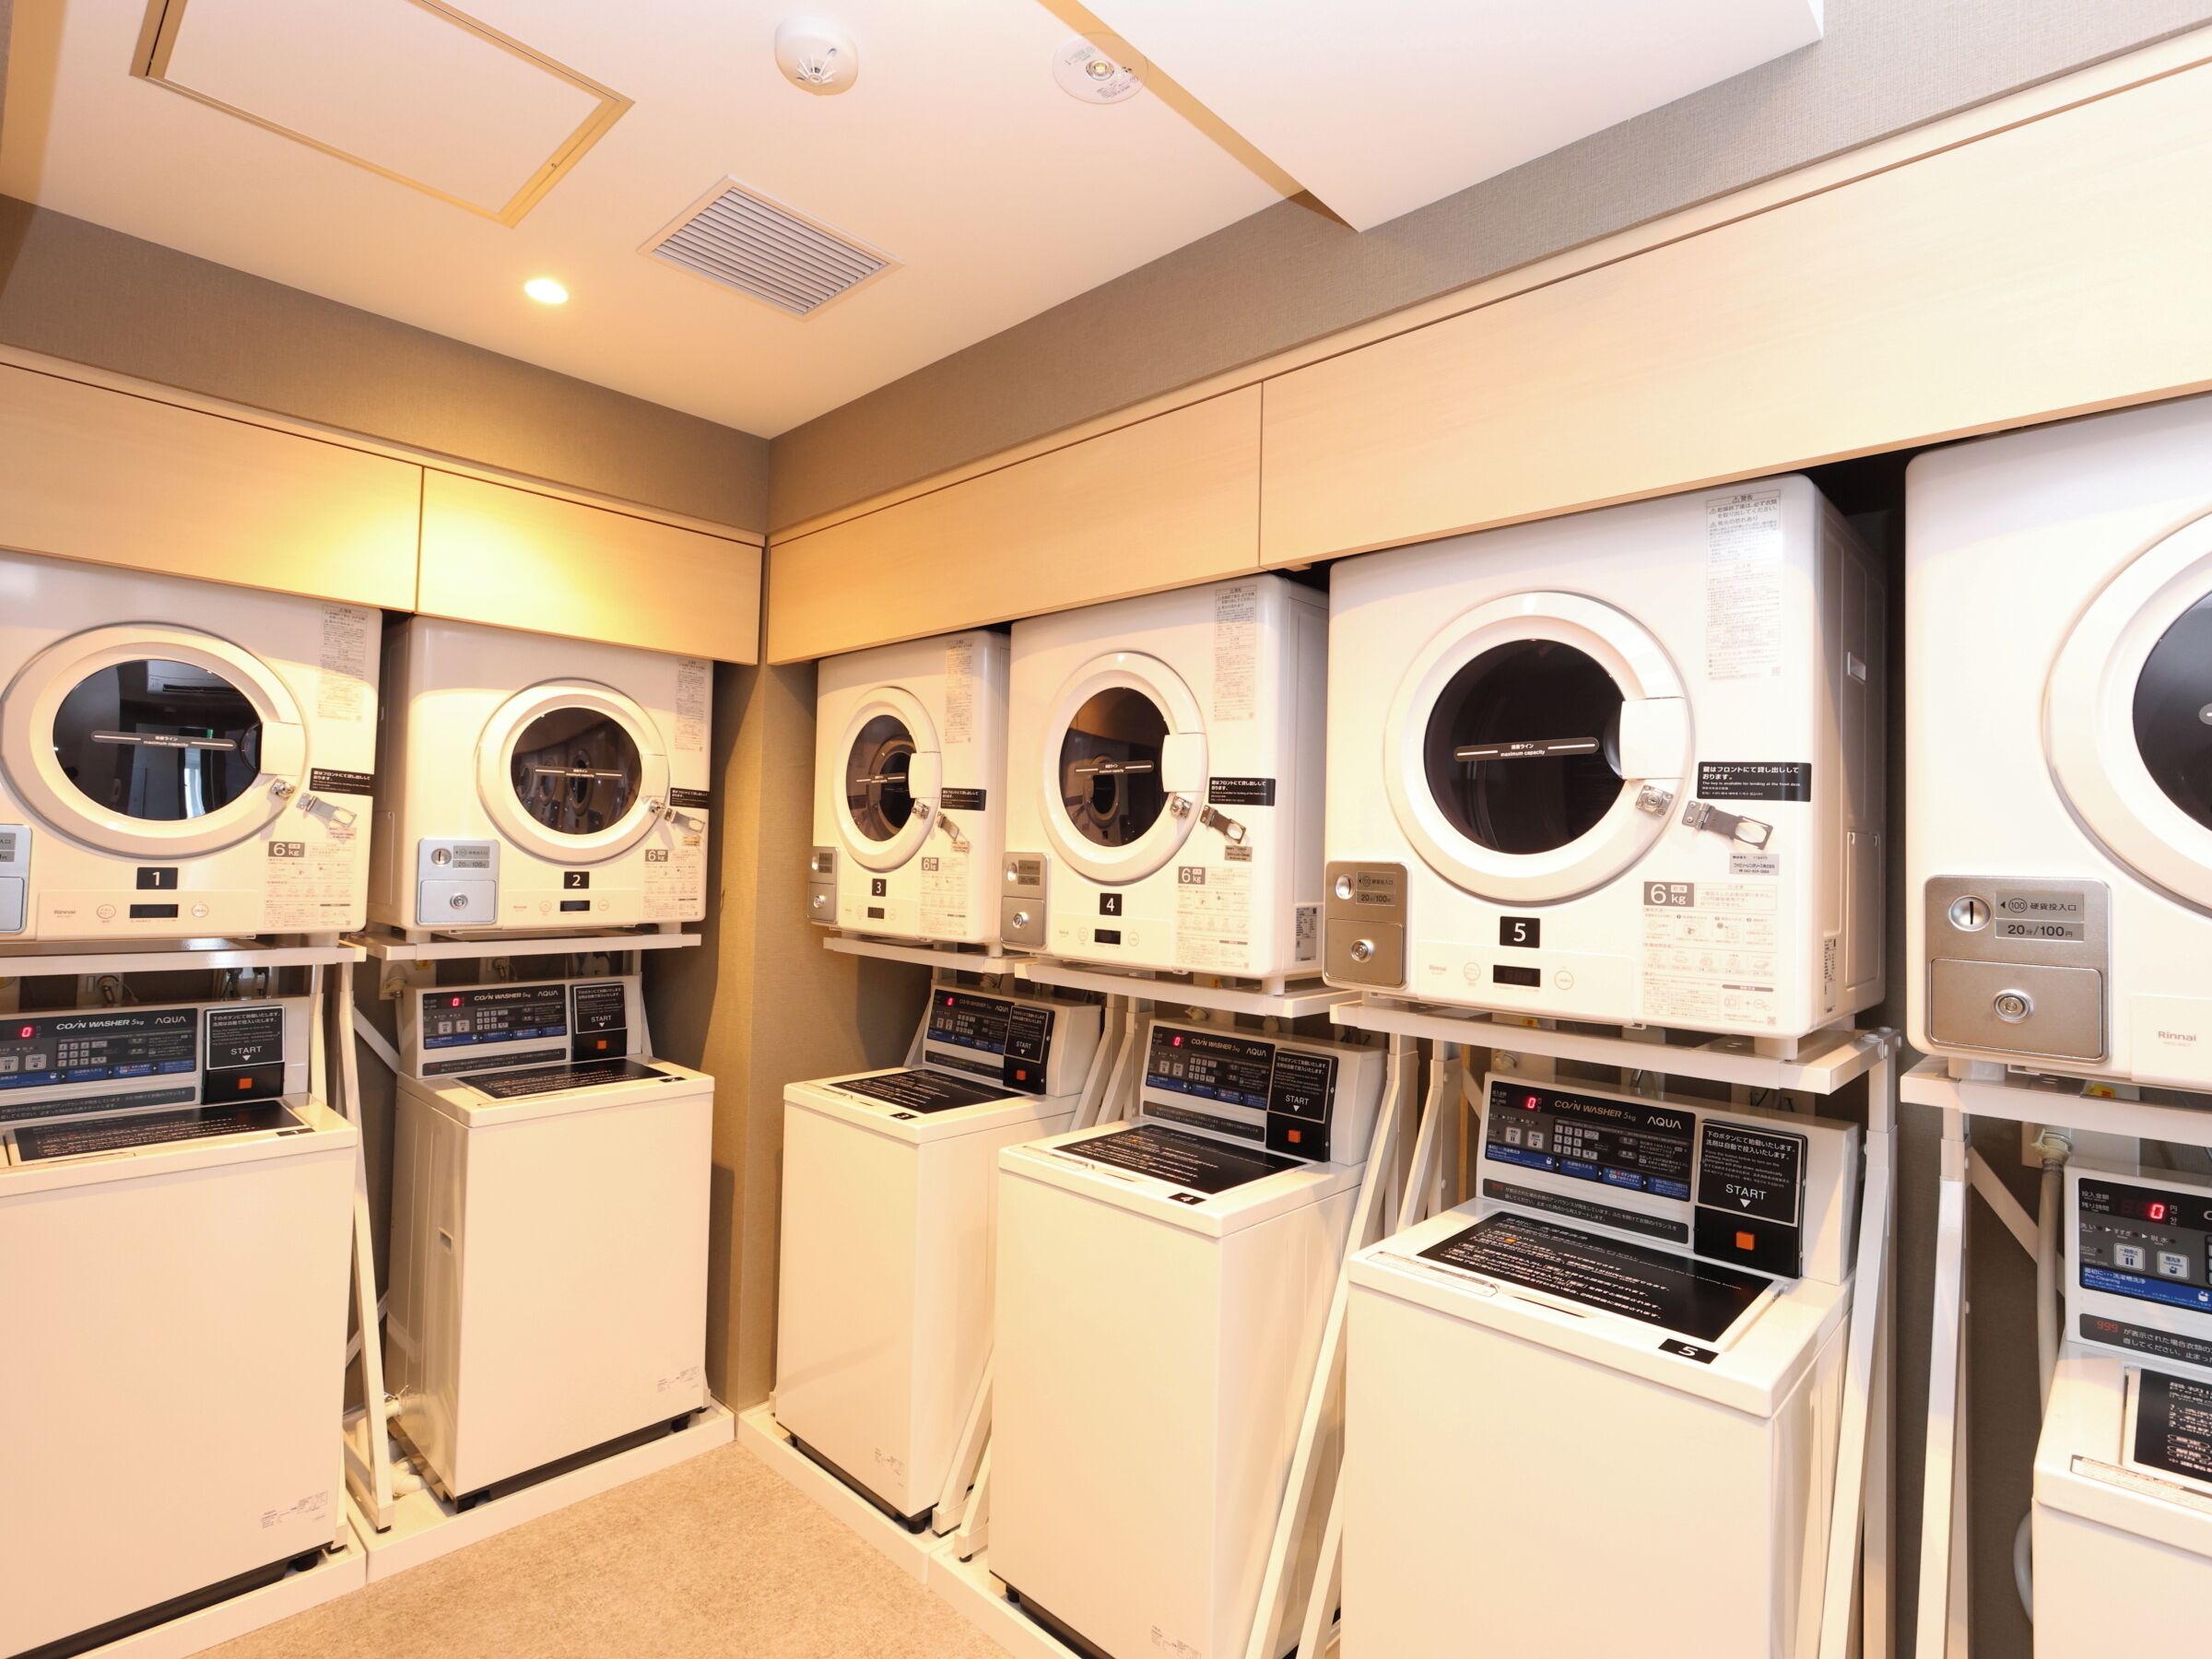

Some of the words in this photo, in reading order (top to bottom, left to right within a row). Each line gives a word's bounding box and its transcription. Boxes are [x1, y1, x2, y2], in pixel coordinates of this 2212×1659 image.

[273, 842, 286, 856] 6
[648, 850, 656, 861] 6
[924, 859, 930, 870] 6
[152, 871, 161, 886] 1
[1181, 867, 1191, 882] 6
[1193, 875, 1202, 885] kg
[571, 875, 581, 886] 2
[876, 882, 881, 893] 3
[1651, 884, 1666, 904] 6
[1671, 894, 1687, 905] kg
[1106, 898, 1115, 912] 4
[2030, 903, 2077, 912] 硬貨投入口
[1512, 923, 1526, 942] 5
[452, 997, 460, 1006] 0
[494, 992, 522, 1000] WASHER
[88, 1018, 130, 1029] WASHER
[155, 1016, 186, 1025] AQUA
[591, 1015, 612, 1023] START
[21, 1027, 32, 1038] 0
[2158, 1030, 2197, 1042] Rinnai
[1016, 1041, 1031, 1049] START
[1173, 1037, 1181, 1046] 0
[230, 1045, 263, 1055] START
[1245, 1047, 1266, 1057] AQUA
[1285, 1094, 1309, 1106] START
[1527, 1097, 1536, 1109] 0
[1554, 1100, 1581, 1111] COIN
[1583, 1105, 1622, 1118] WASHER
[1647, 1115, 1682, 1130] AQUA
[1725, 1183, 1767, 1200] START
[2150, 1203, 2165, 1219] 0
[1678, 1346, 1699, 1358] 5
